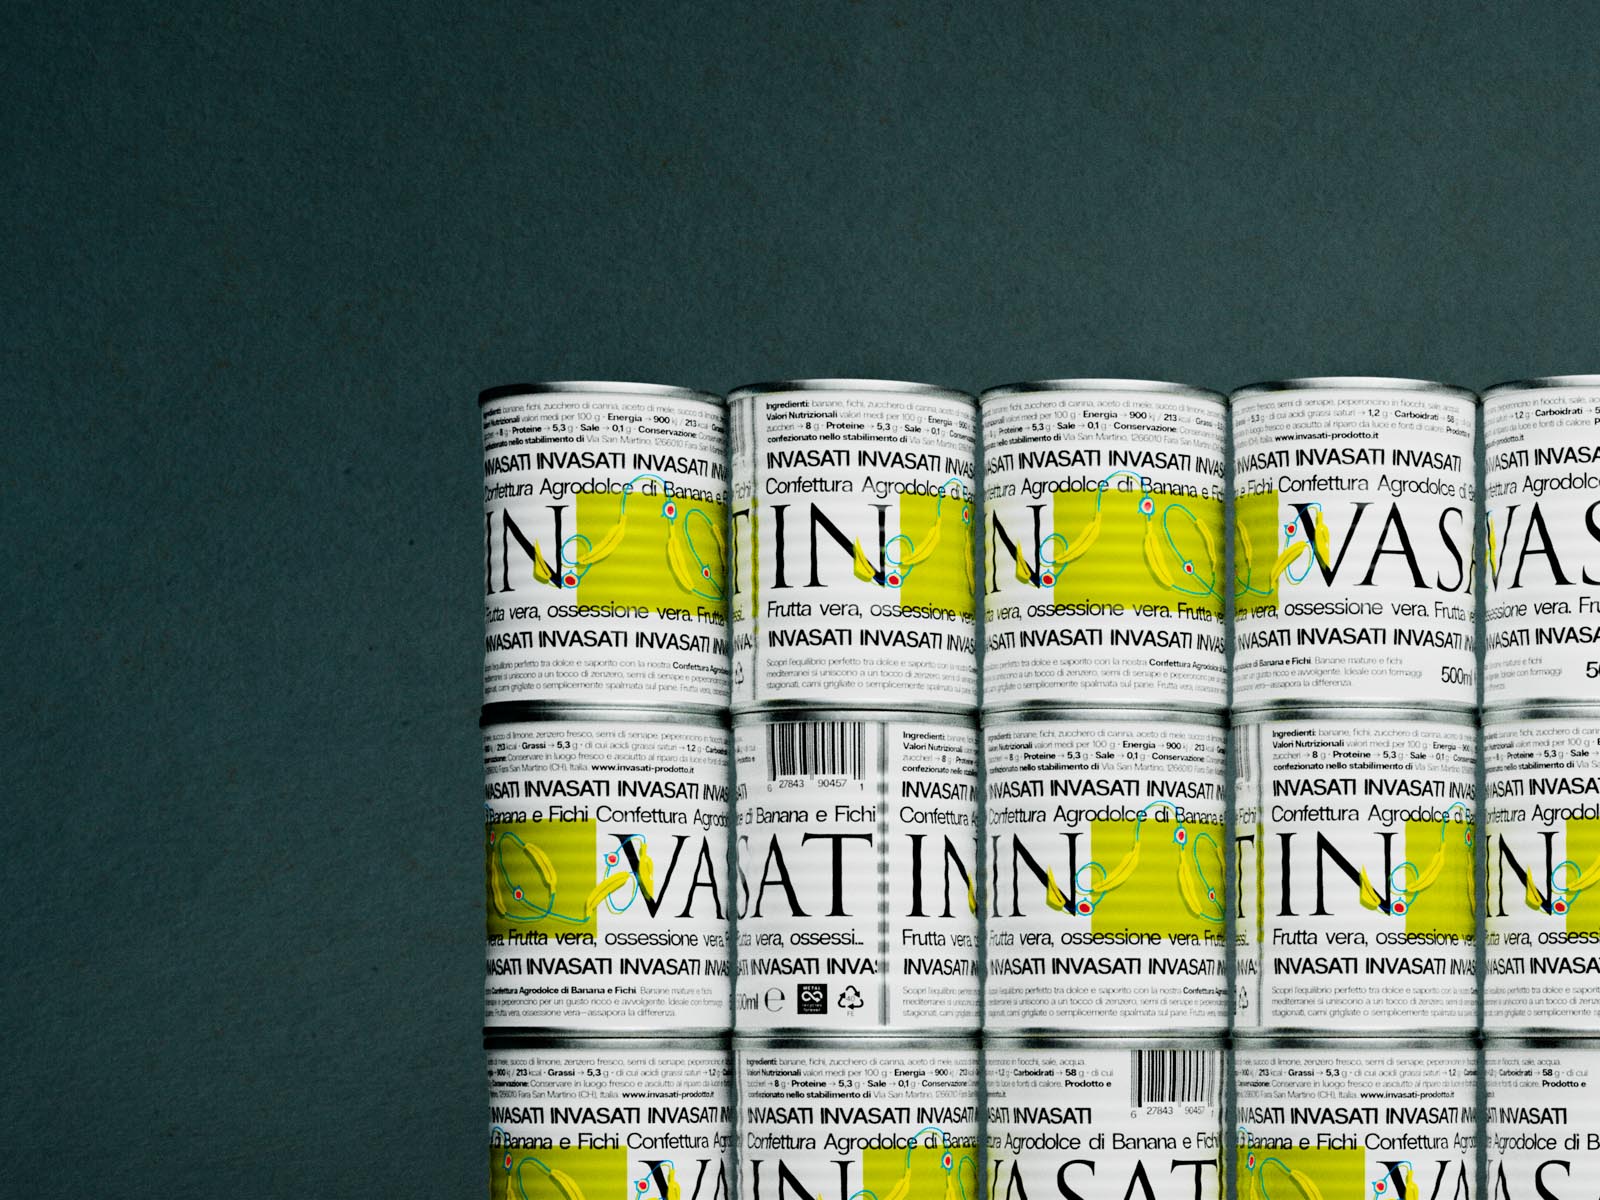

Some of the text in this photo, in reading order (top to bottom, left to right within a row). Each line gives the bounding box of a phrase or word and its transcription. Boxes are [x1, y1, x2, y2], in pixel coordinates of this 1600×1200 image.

[537, 452, 625, 469] INVASATI
[767, 450, 849, 469] INVASATI
[1019, 450, 1100, 469] INVASATI
[1296, 448, 1384, 466] INVASATI
[766, 476, 852, 494] Confettura
[1279, 475, 1368, 492] Confettura
[548, 601, 648, 618] ossessione
[525, 780, 609, 797] INVASATI
[1051, 780, 1139, 796] INVASATI
[1273, 779, 1356, 796] INVASATI
[836, 806, 875, 822] Fichi
[1053, 805, 1147, 827] Agrodolce
[505, 925, 596, 947] Frutta vera,
[551, 1107, 640, 1124] INVASATI
[821, 1108, 910, 1124] INVASATI
[1014, 1107, 1091, 1124] INVASATI
[1291, 1108, 1378, 1124] INVASATI
[1500, 1108, 1567, 1124] INVASATI
[578, 1133, 619, 1150] Fichi
[824, 1133, 917, 1155] Agrodolce
[1113, 1133, 1176, 1149] Banana
[1317, 1133, 1357, 1150] Fichi
